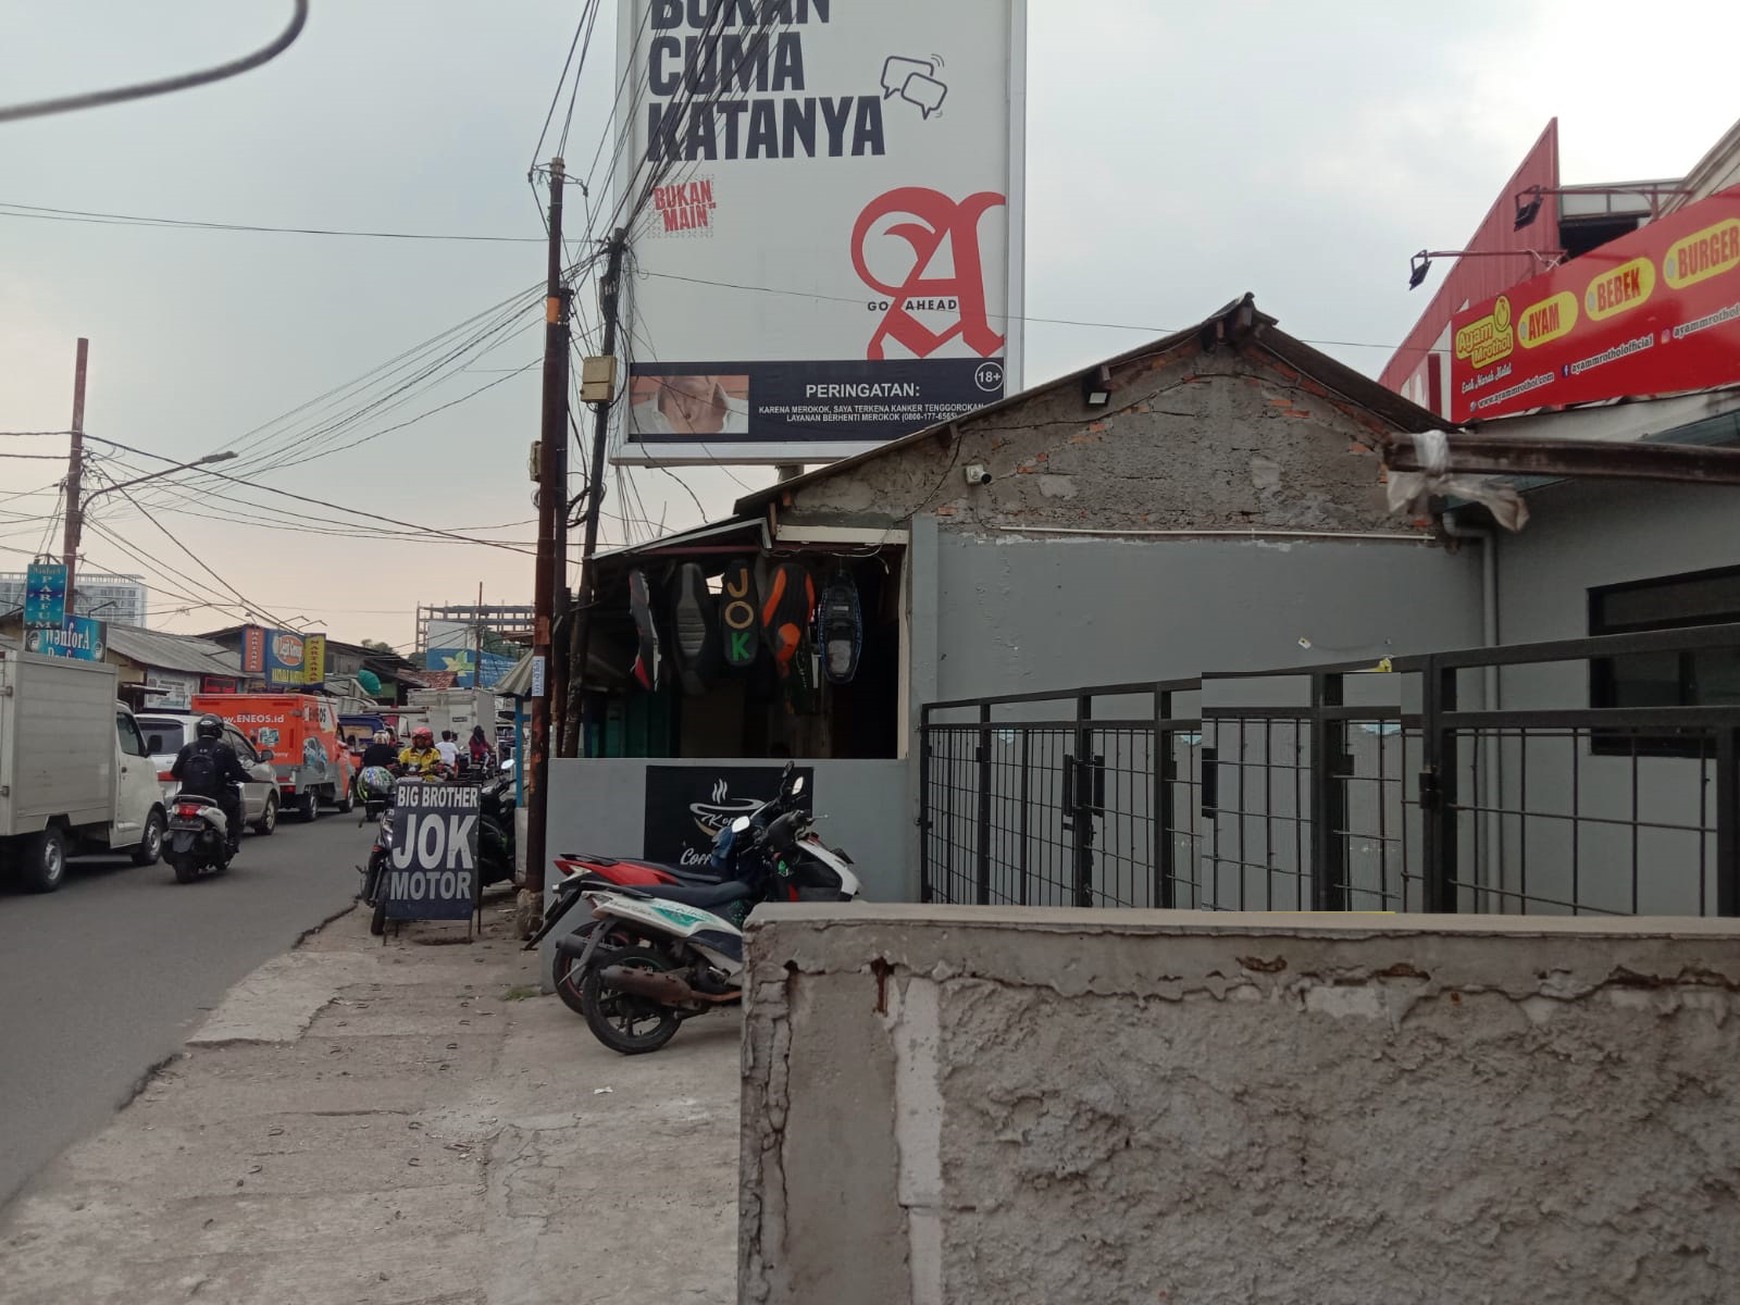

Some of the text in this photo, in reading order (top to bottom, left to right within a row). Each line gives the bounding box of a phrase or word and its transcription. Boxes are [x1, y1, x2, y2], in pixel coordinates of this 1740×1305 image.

[648, 31, 805, 96] CUMA
[646, 95, 886, 162] KATANYA
[655, 179, 712, 210] BUKAN
[1677, 226, 1740, 280] BURGER
[1597, 267, 1642, 312] BEBEK
[867, 300, 958, 312] GO AHEAD
[1528, 302, 1560, 341] AYAM
[1458, 323, 1493, 353] Ayam
[806, 382, 921, 399] PERINGATAN:
[978, 371, 1002, 383] 18+
[759, 406, 790, 414] KARENA
[833, 405, 853, 413] SAYA
[854, 405, 890, 413] TERKENA
[891, 404, 923, 412] KANKER
[787, 414, 821, 422] LAYANAN
[823, 414, 861, 422] BERHENTI
[862, 413, 900, 421] MEROKOK
[397, 785, 478, 808] BIG BROTHER
[392, 813, 478, 870] JOK
[390, 871, 471, 900] MOTOR
